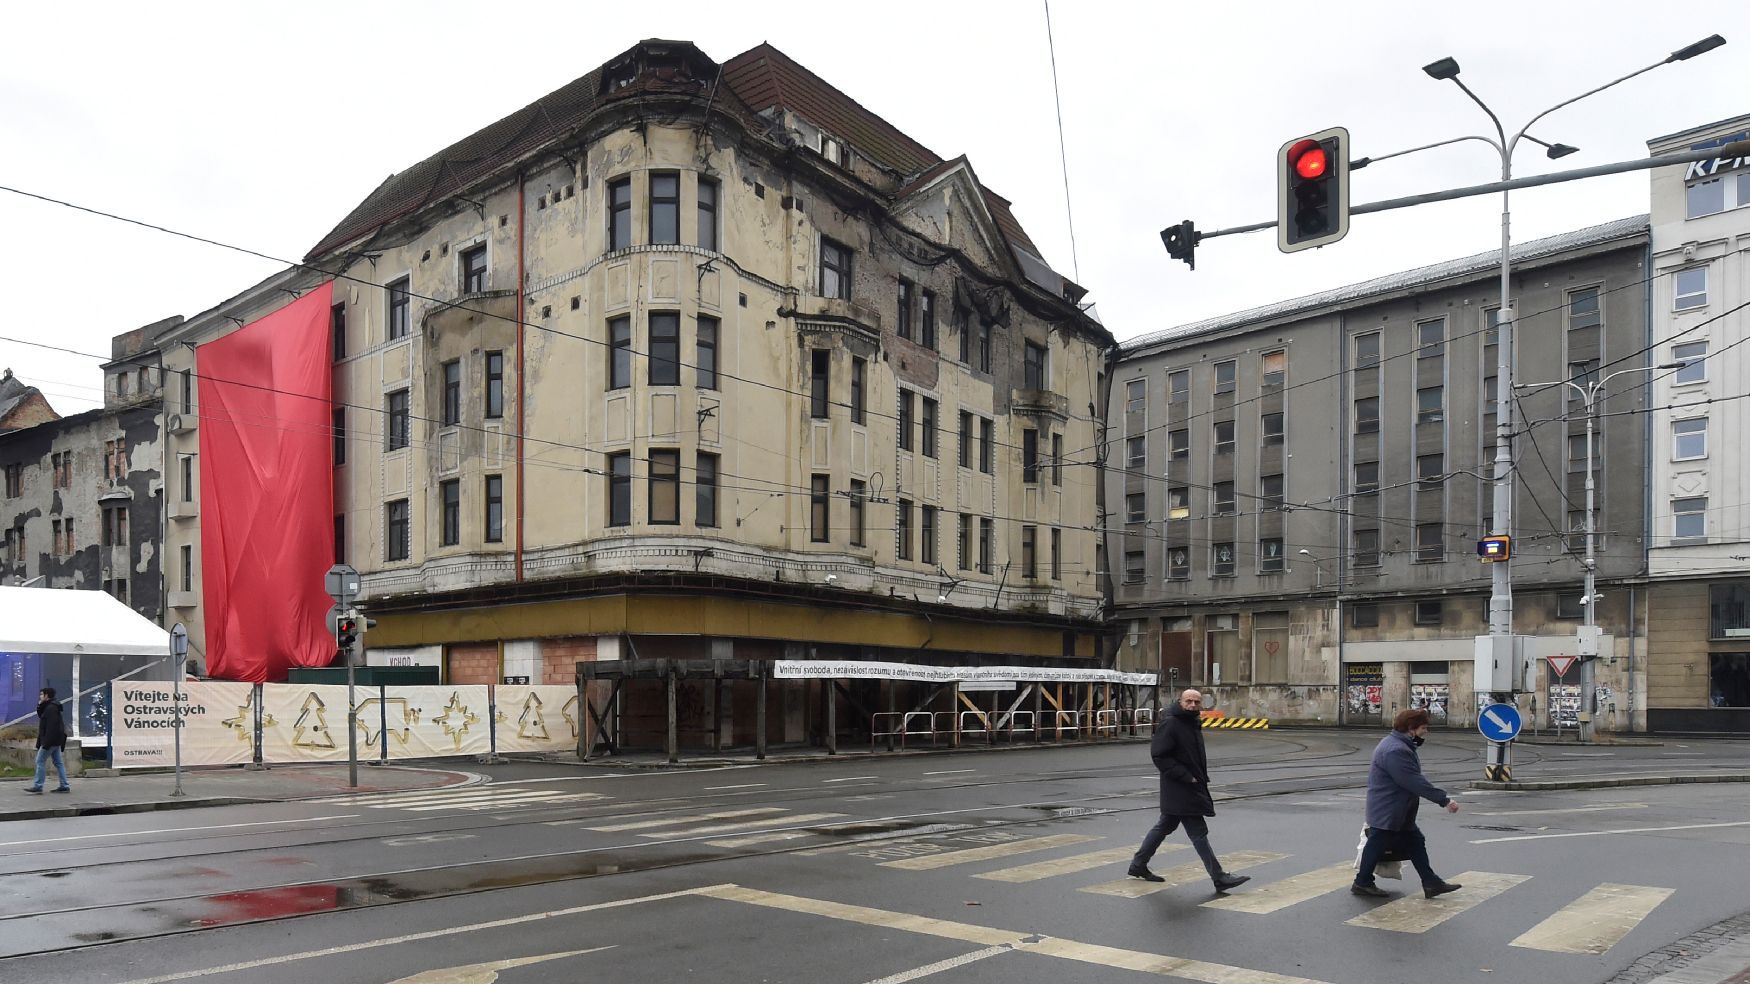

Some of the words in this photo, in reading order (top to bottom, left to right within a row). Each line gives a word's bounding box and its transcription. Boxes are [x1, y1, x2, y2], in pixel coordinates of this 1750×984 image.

[779, 665, 801, 674] Vnitřní
[803, 665, 832, 675] svoboda,
[834, 666, 867, 675] nezávislost
[124, 690, 169, 703] Vítejte
[173, 693, 188, 701] na
[124, 717, 185, 729] Vánocích
